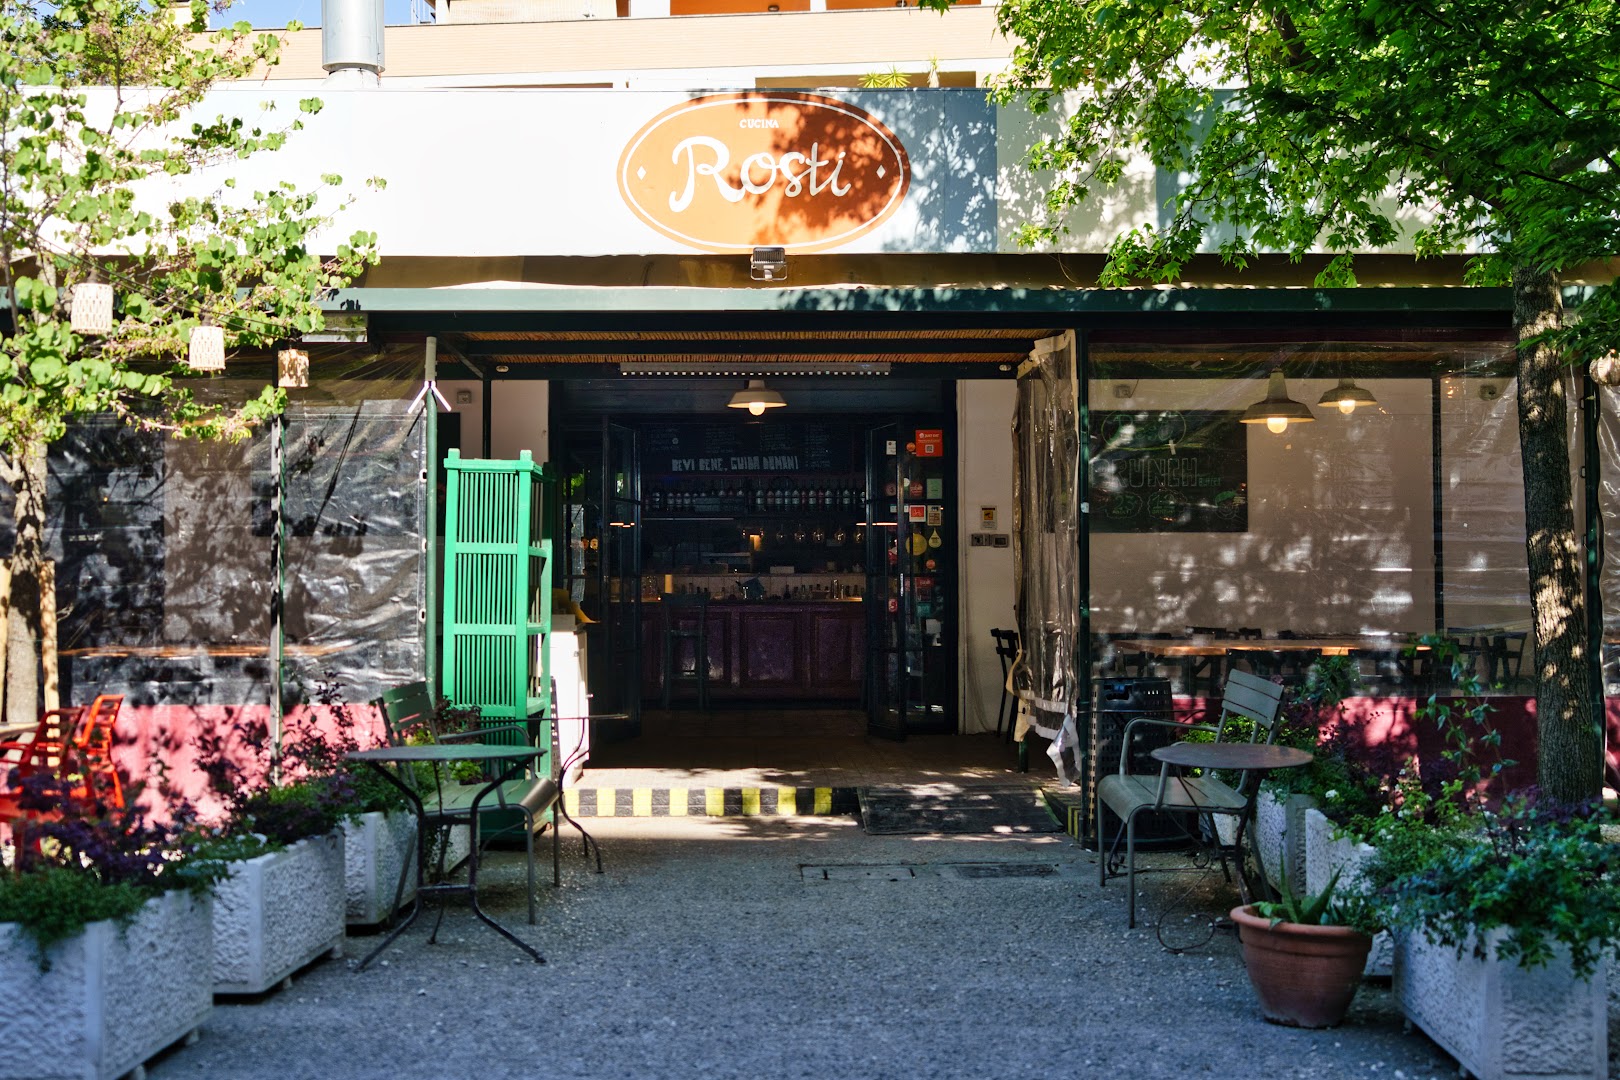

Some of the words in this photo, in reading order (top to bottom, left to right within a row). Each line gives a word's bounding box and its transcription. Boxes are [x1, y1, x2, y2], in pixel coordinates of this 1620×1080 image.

[739, 118, 779, 129] CUCINA
[668, 135, 852, 213] Rosti
[671, 458, 696, 472] BEVI
